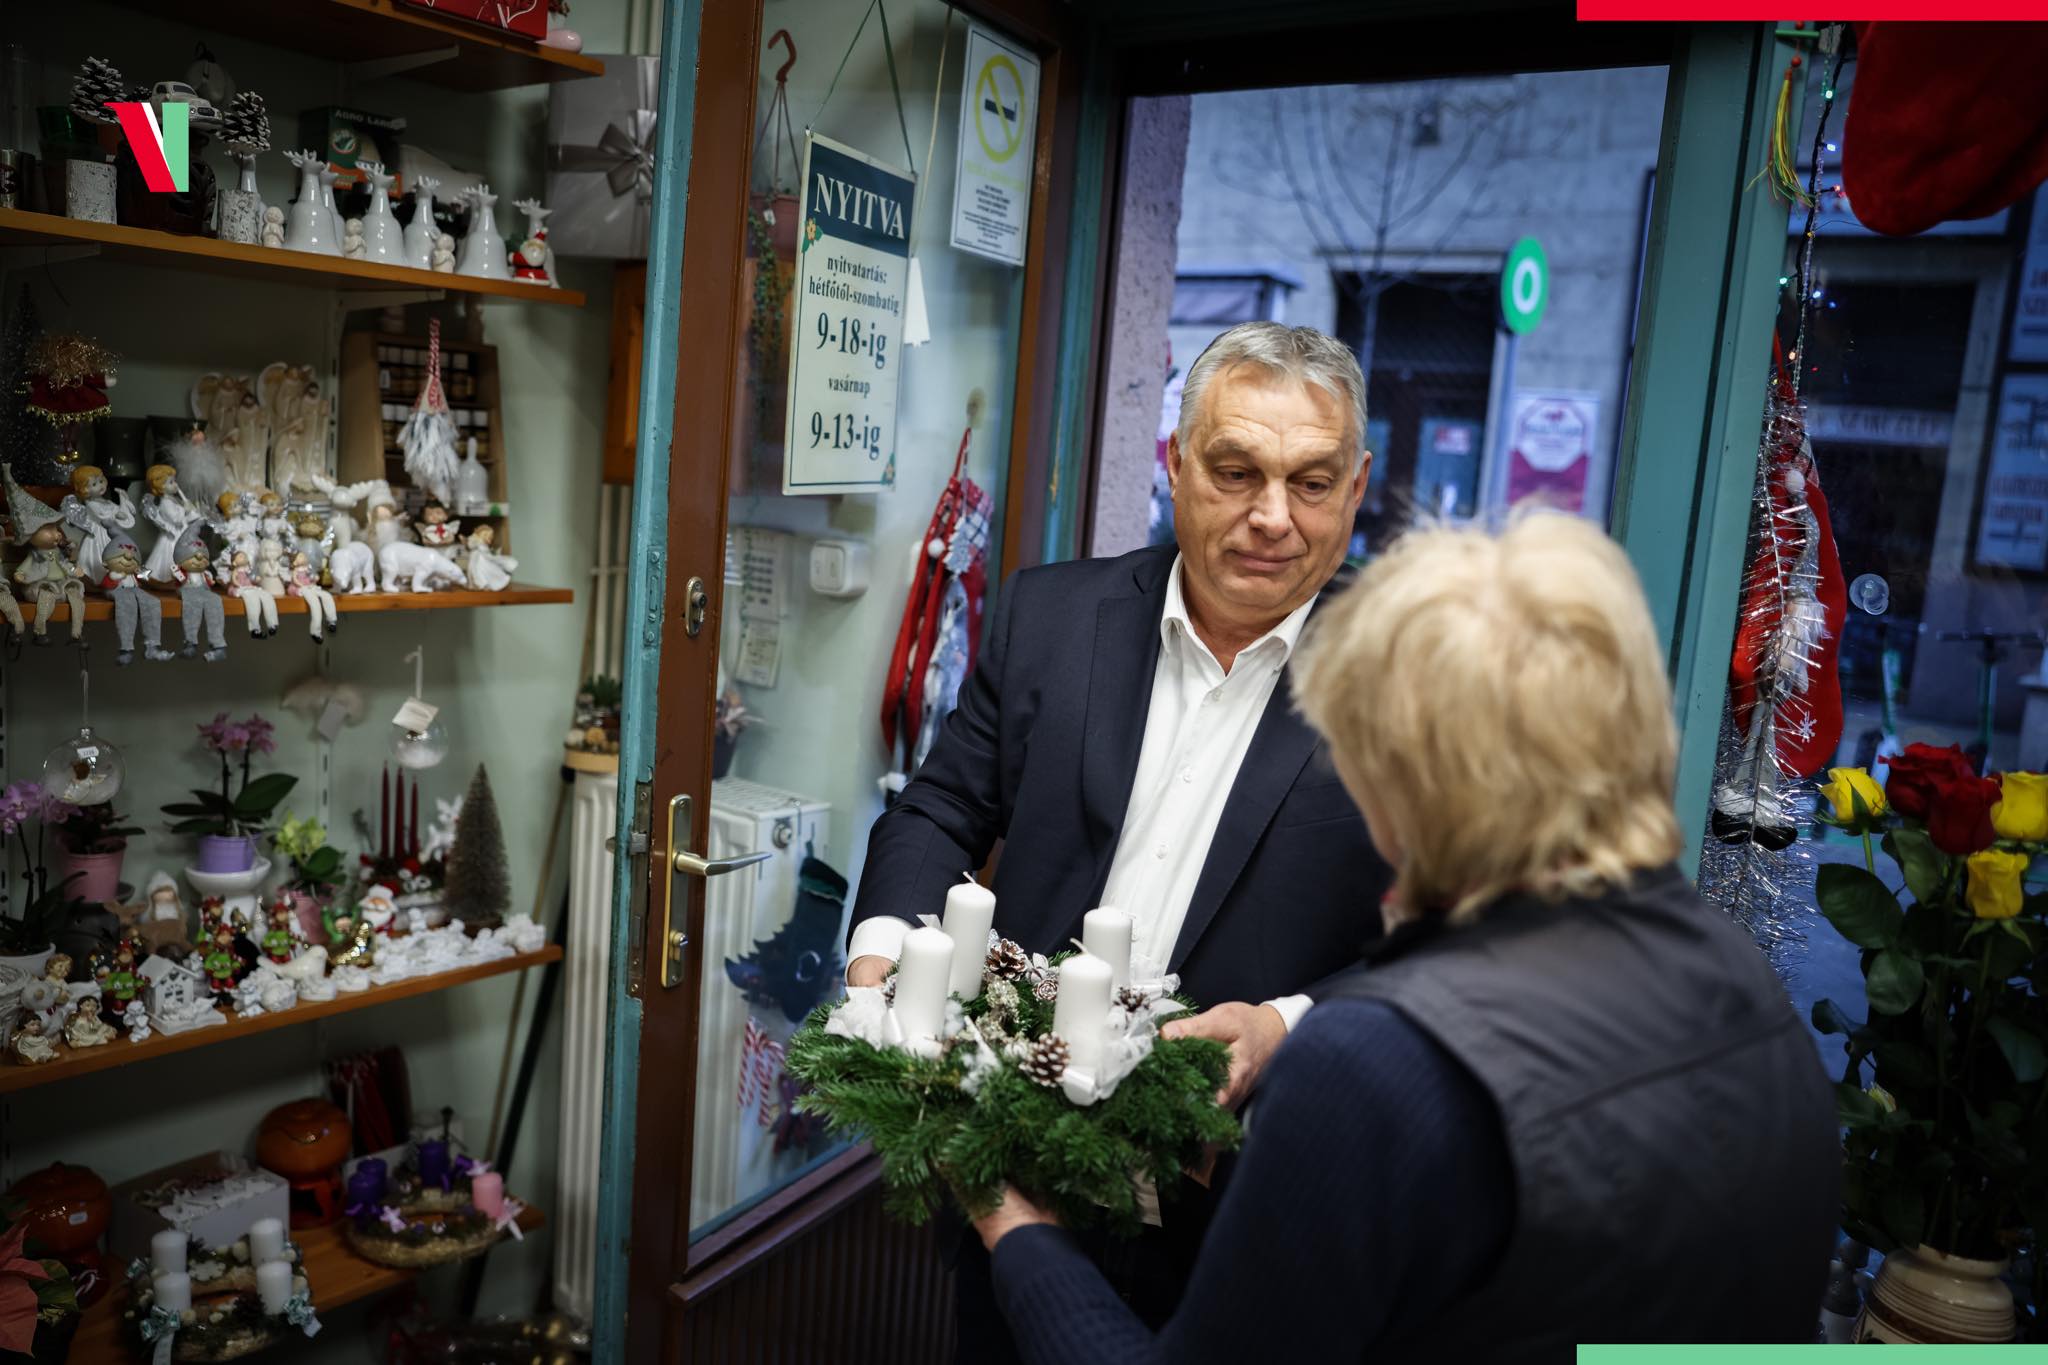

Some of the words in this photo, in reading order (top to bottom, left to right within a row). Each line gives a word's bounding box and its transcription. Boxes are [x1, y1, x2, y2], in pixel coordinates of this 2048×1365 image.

[814, 173, 905, 239] NYITVA
[827, 256, 887, 284] nyitvatartás:
[816, 312, 887, 370] 9-18-ig
[828, 373, 871, 399] vasárnap
[810, 411, 881, 460] 9-13-ig
